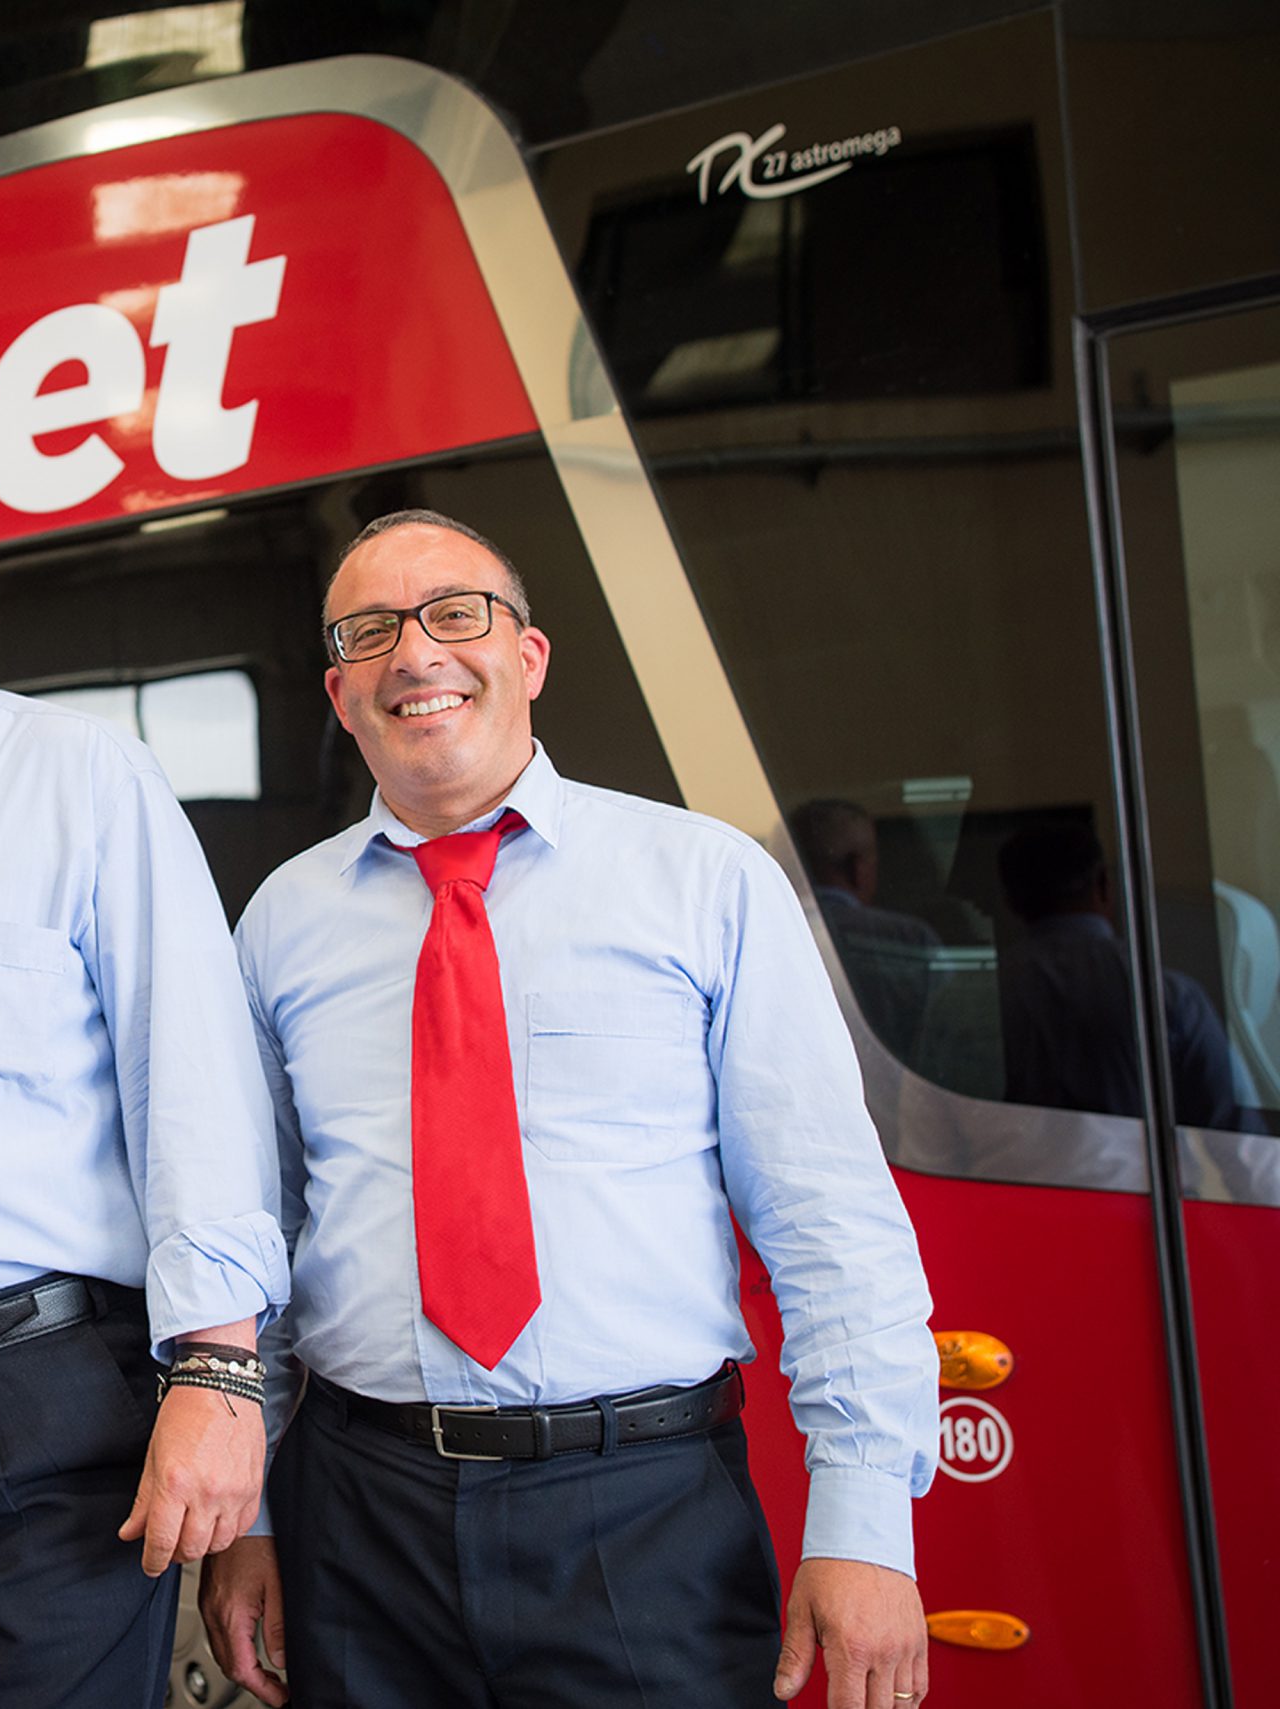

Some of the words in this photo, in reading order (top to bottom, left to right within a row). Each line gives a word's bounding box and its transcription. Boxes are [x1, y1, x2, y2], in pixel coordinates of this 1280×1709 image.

[763, 151, 788, 179] 27
[791, 126, 901, 172] astromega
[940, 1416, 1000, 1462] 180
